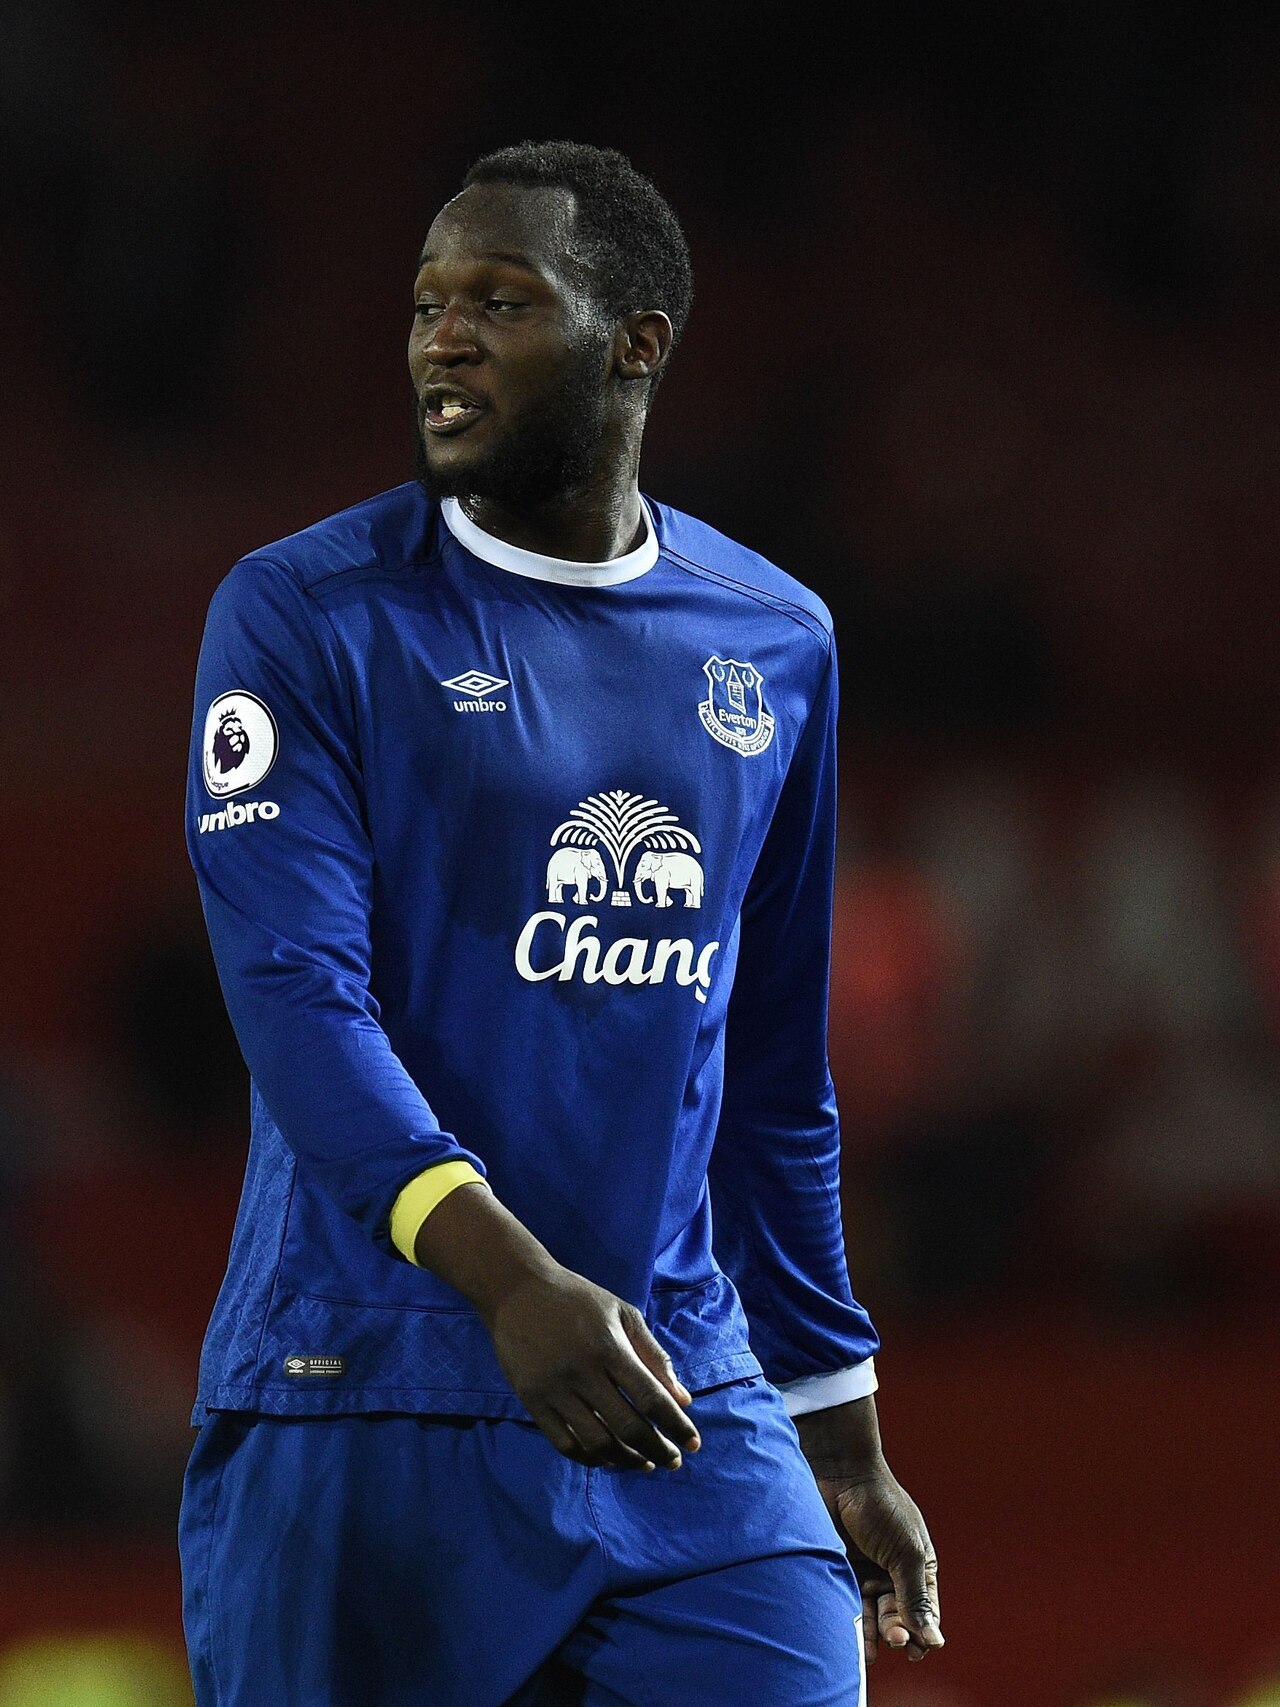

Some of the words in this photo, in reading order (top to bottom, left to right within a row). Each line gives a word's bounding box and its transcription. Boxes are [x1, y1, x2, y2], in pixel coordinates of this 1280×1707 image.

[453, 698, 507, 712] umbro
[718, 709, 756, 729] Everton
[198, 801, 280, 834] umbro
